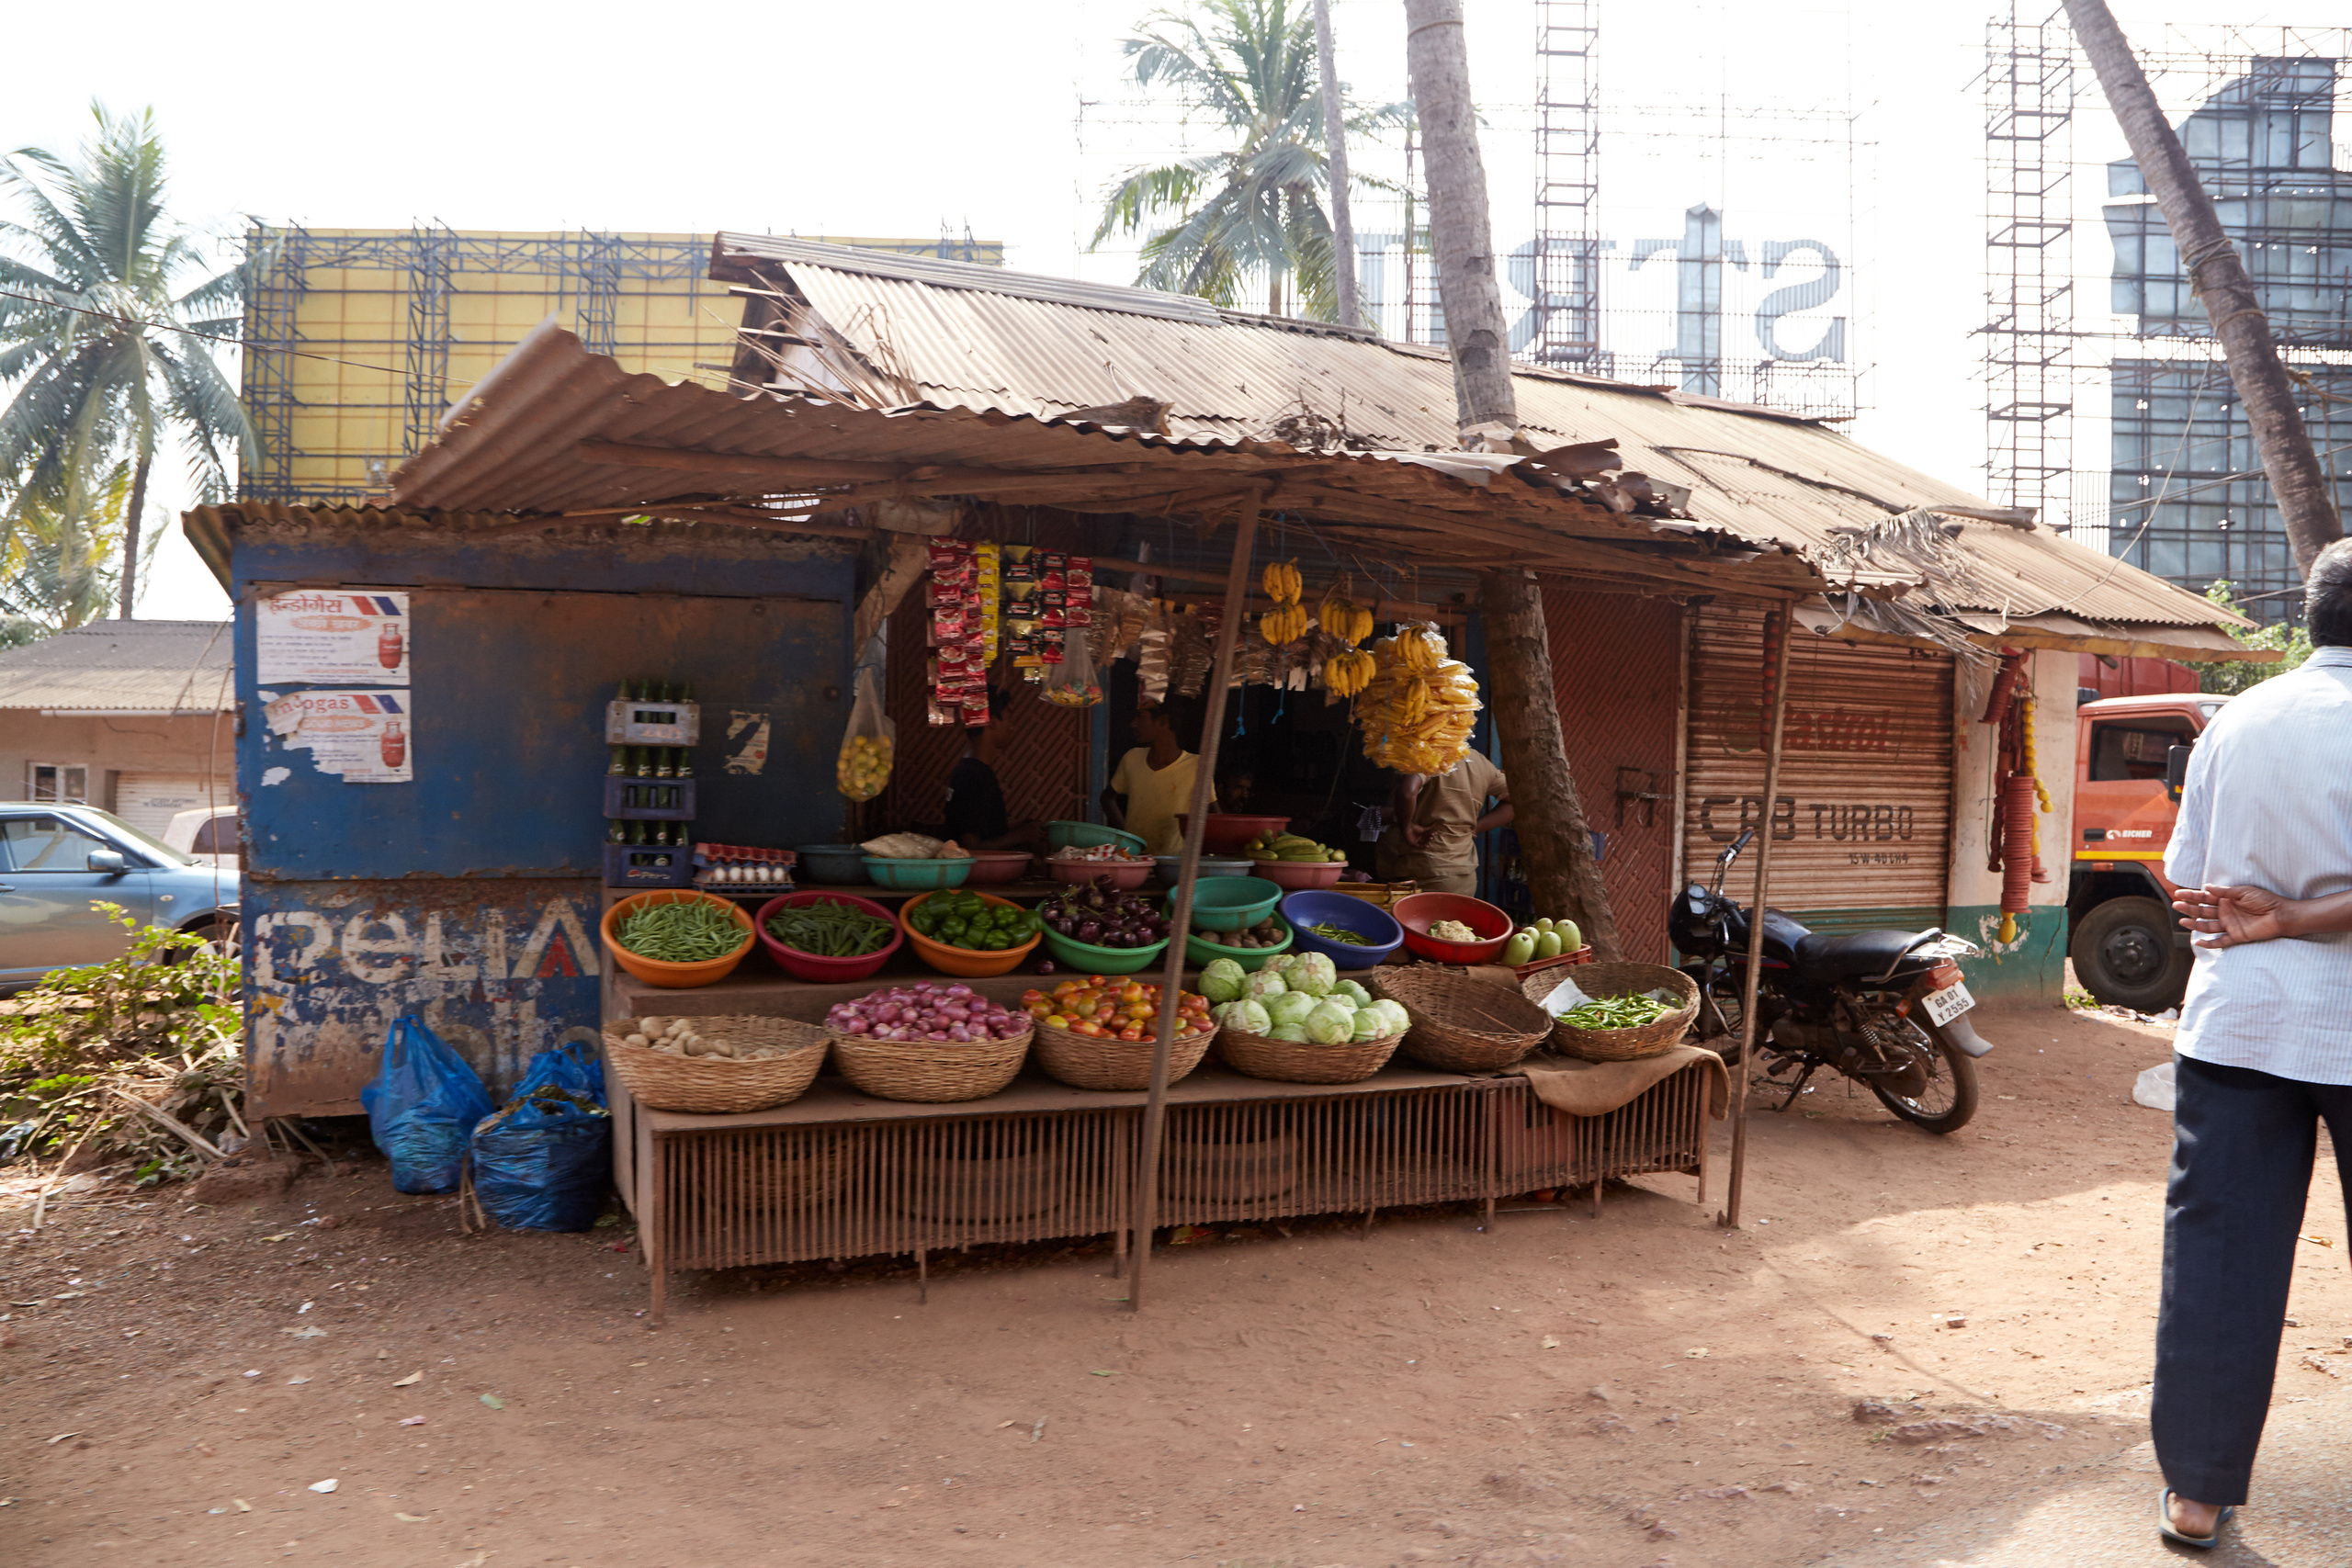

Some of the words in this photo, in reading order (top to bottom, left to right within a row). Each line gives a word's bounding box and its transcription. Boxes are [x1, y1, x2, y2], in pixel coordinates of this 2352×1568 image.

[1809, 804, 1913, 840] TURBO
[2122, 829, 2153, 838] EICHER
[1935, 996, 1949, 1009] GA
[1948, 989, 1959, 1001] 01
[1938, 1012, 1945, 1021] Y
[1946, 998, 1969, 1017] 2555
